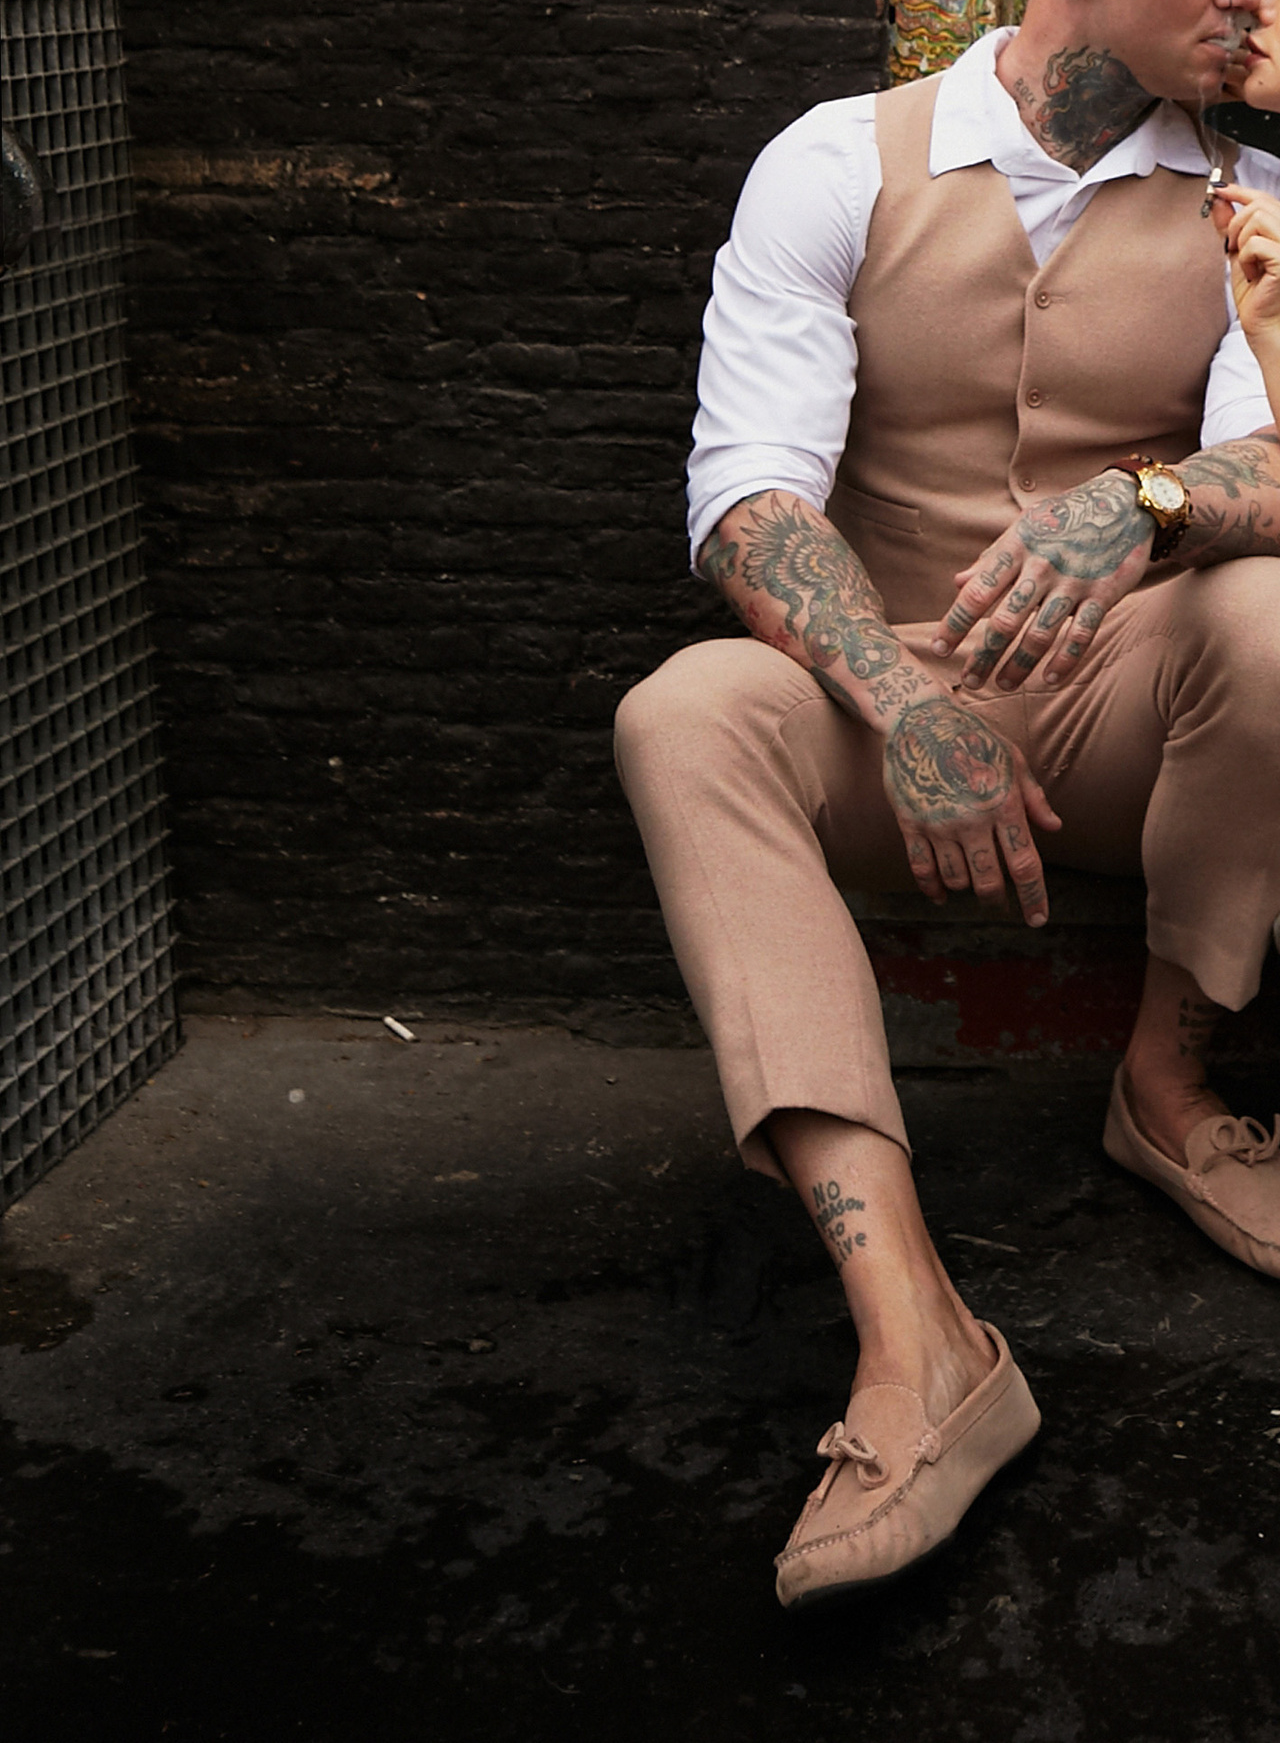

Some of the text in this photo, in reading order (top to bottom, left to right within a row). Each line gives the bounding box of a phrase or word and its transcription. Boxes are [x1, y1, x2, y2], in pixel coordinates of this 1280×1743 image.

[868, 665, 915, 703] DEAD
[875, 672, 933, 717] INSIDE
[812, 1180, 840, 1209] NO
